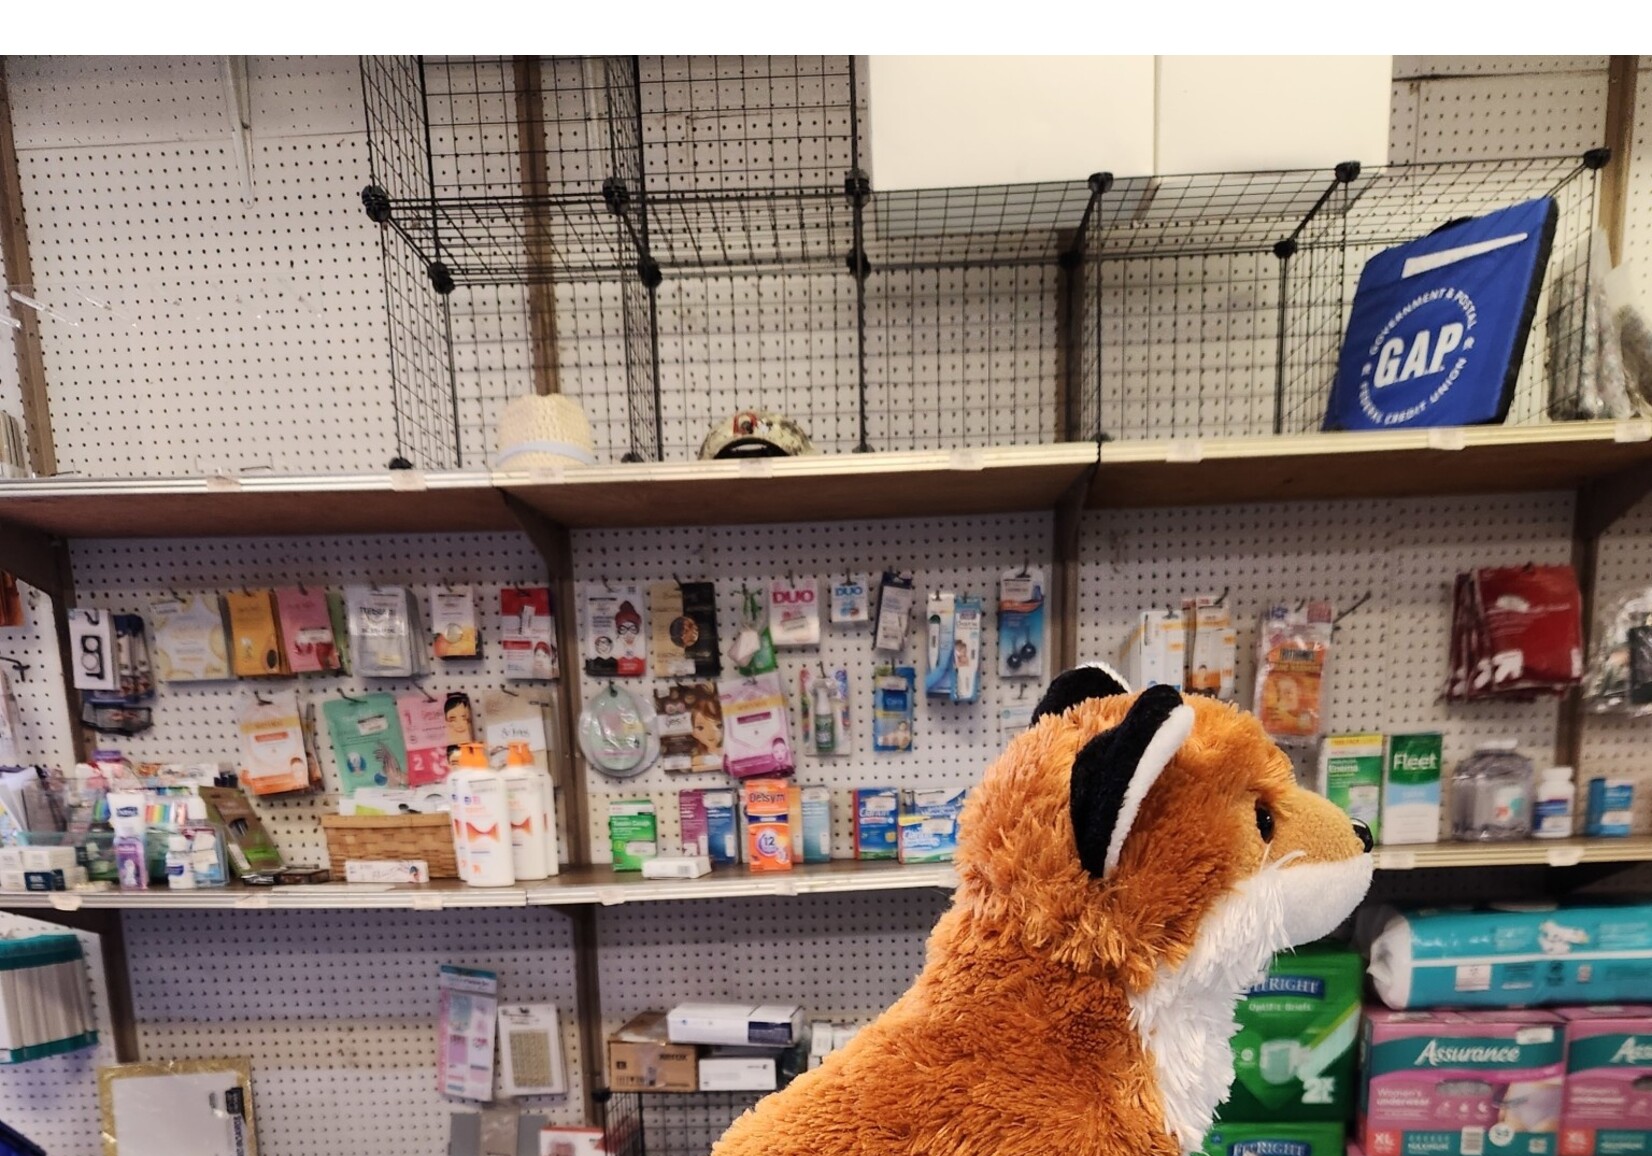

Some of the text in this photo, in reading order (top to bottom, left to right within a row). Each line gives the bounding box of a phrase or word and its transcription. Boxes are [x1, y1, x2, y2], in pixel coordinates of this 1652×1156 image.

[1368, 288, 1446, 356] GOVERNMENT
[1454, 290, 1478, 330] POSTAL
[1383, 401, 1427, 425] CREDIT
[1429, 357, 1467, 404] UNION
[772, 590, 815, 604] DUO
[834, 586, 863, 597] DUO
[412, 756, 425, 771] 2
[1393, 752, 1438, 771] Fleet
[749, 792, 785, 804] Delsym
[763, 836, 775, 846] 12
[1414, 1039, 1521, 1067] Assurance
[1373, 1132, 1395, 1146] XL
